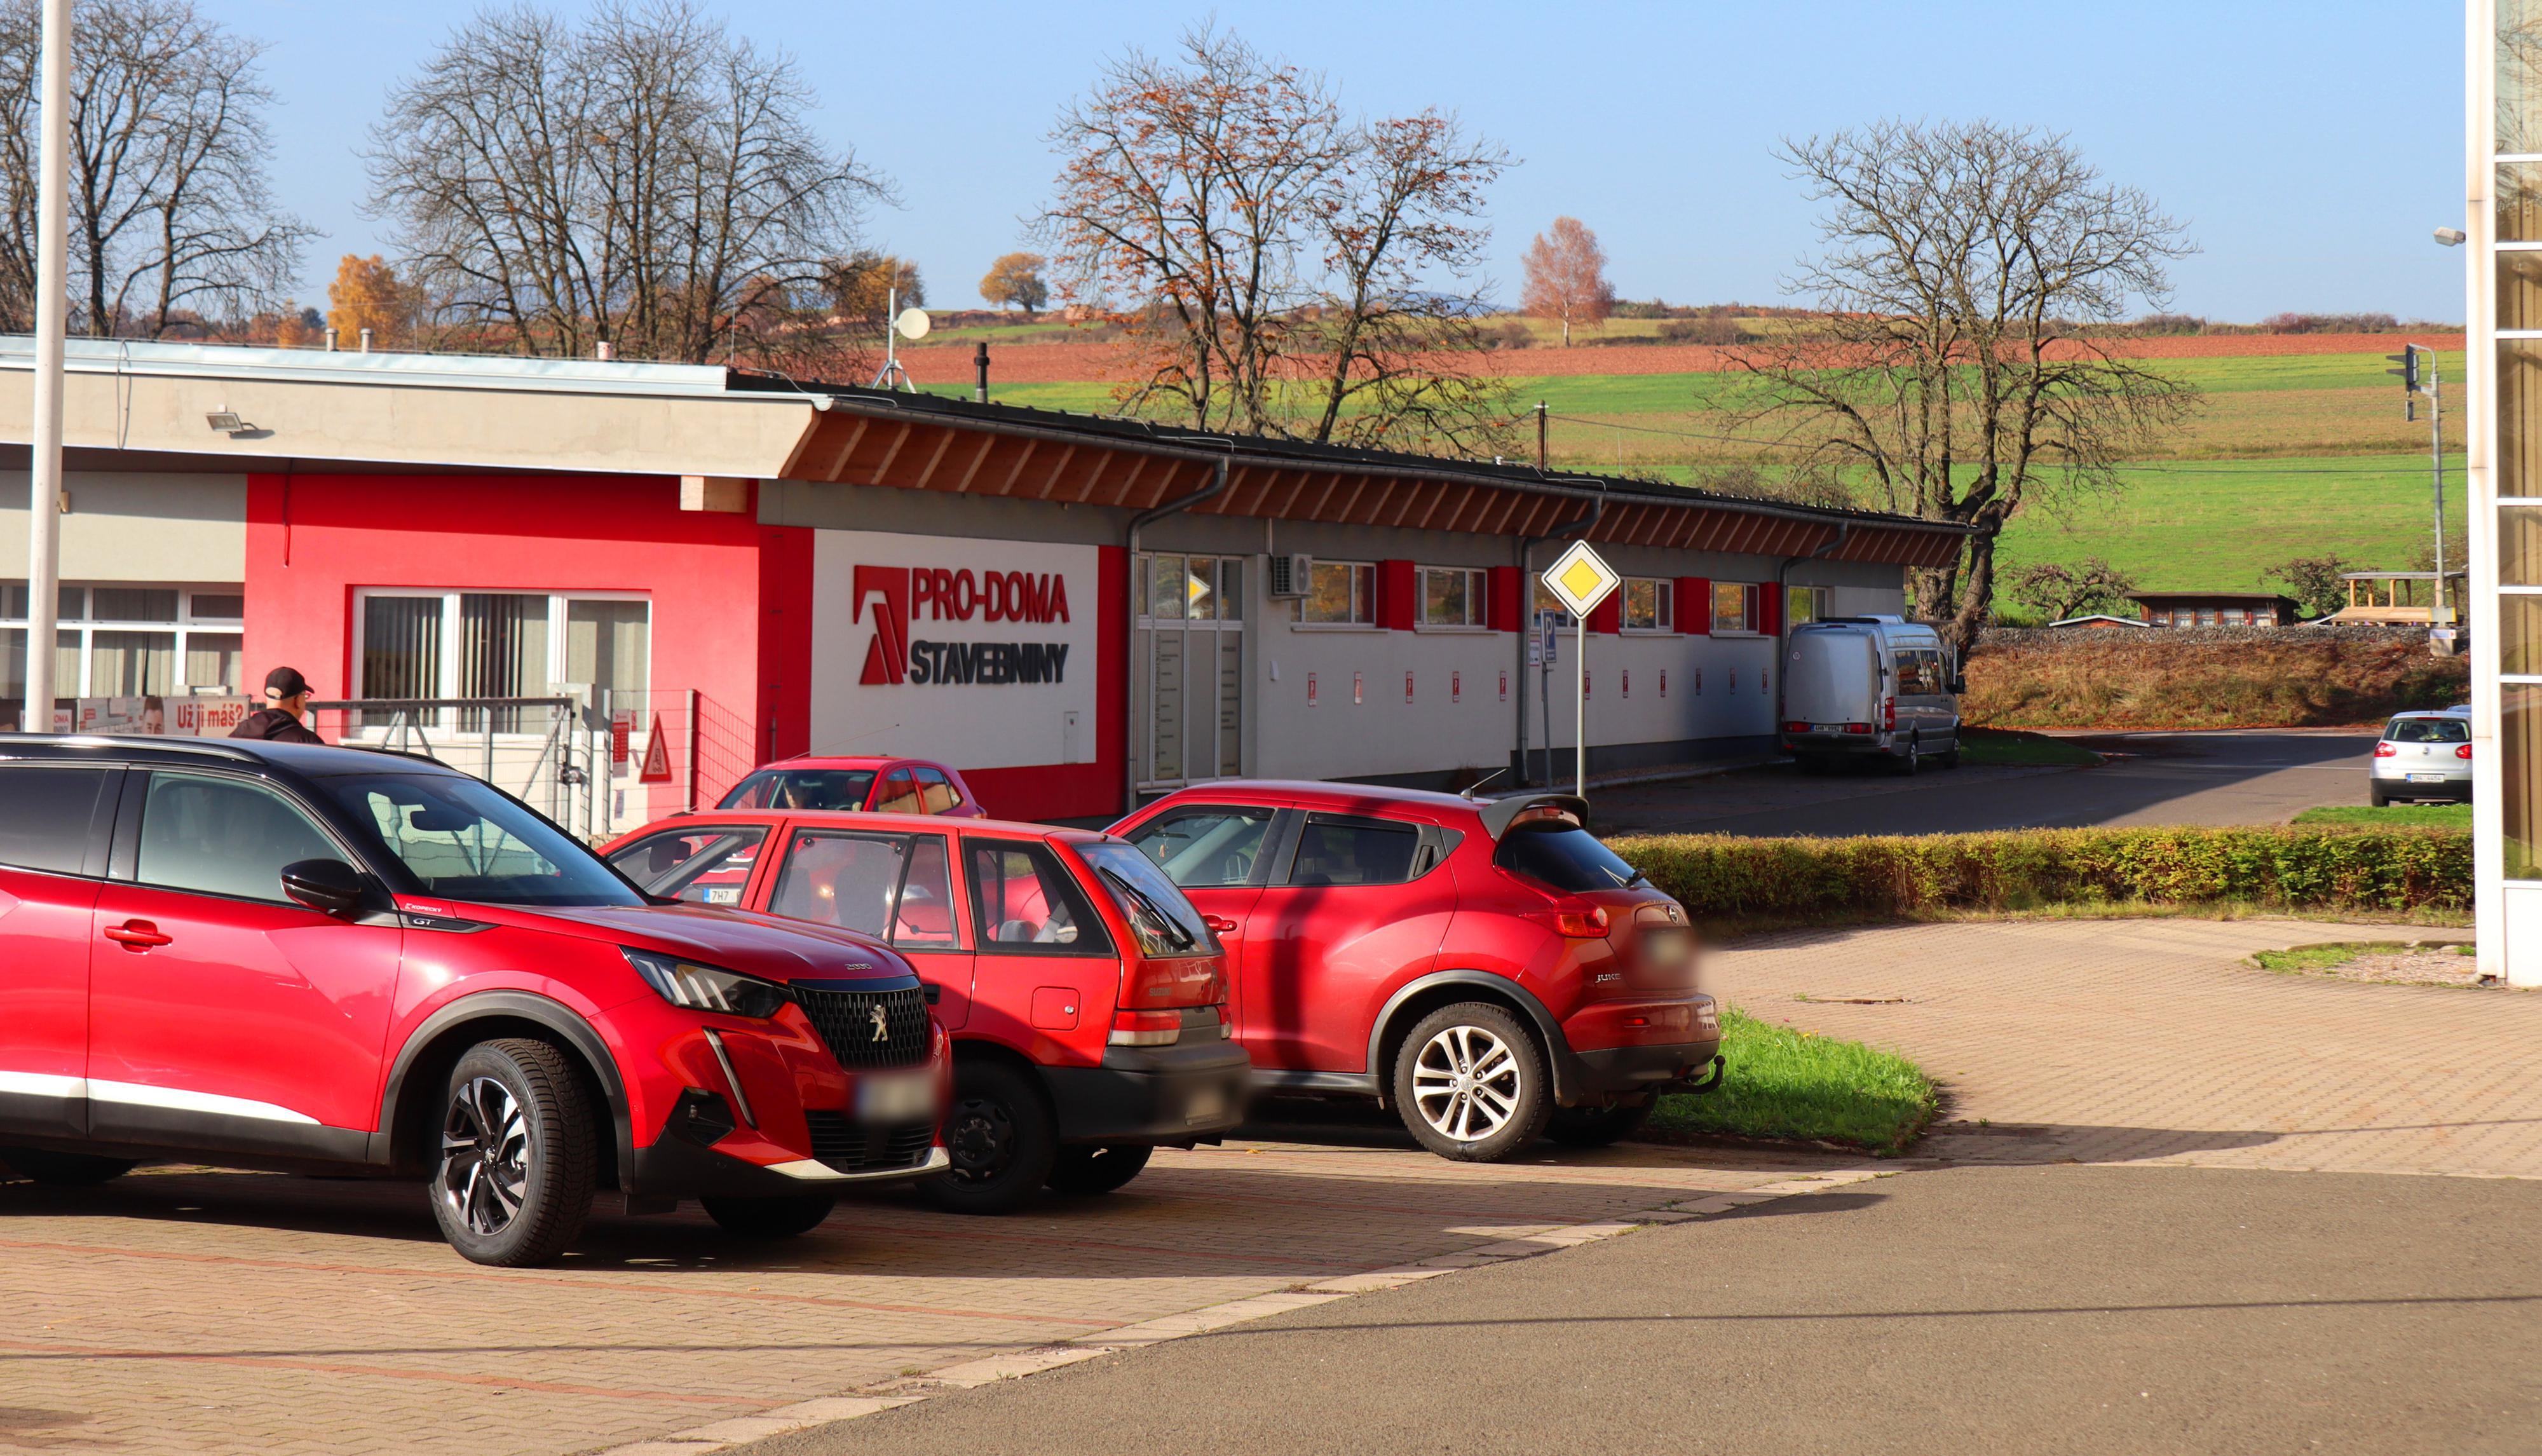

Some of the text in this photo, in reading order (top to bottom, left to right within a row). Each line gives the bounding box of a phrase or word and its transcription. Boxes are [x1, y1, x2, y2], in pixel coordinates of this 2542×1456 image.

[912, 568, 1070, 623] PRO-DOMA
[1546, 616, 1553, 646] P
[910, 640, 1069, 684] STAVEBNINY
[177, 703, 243, 736] Už ji máš?
[1594, 973, 1622, 983] JUKE
